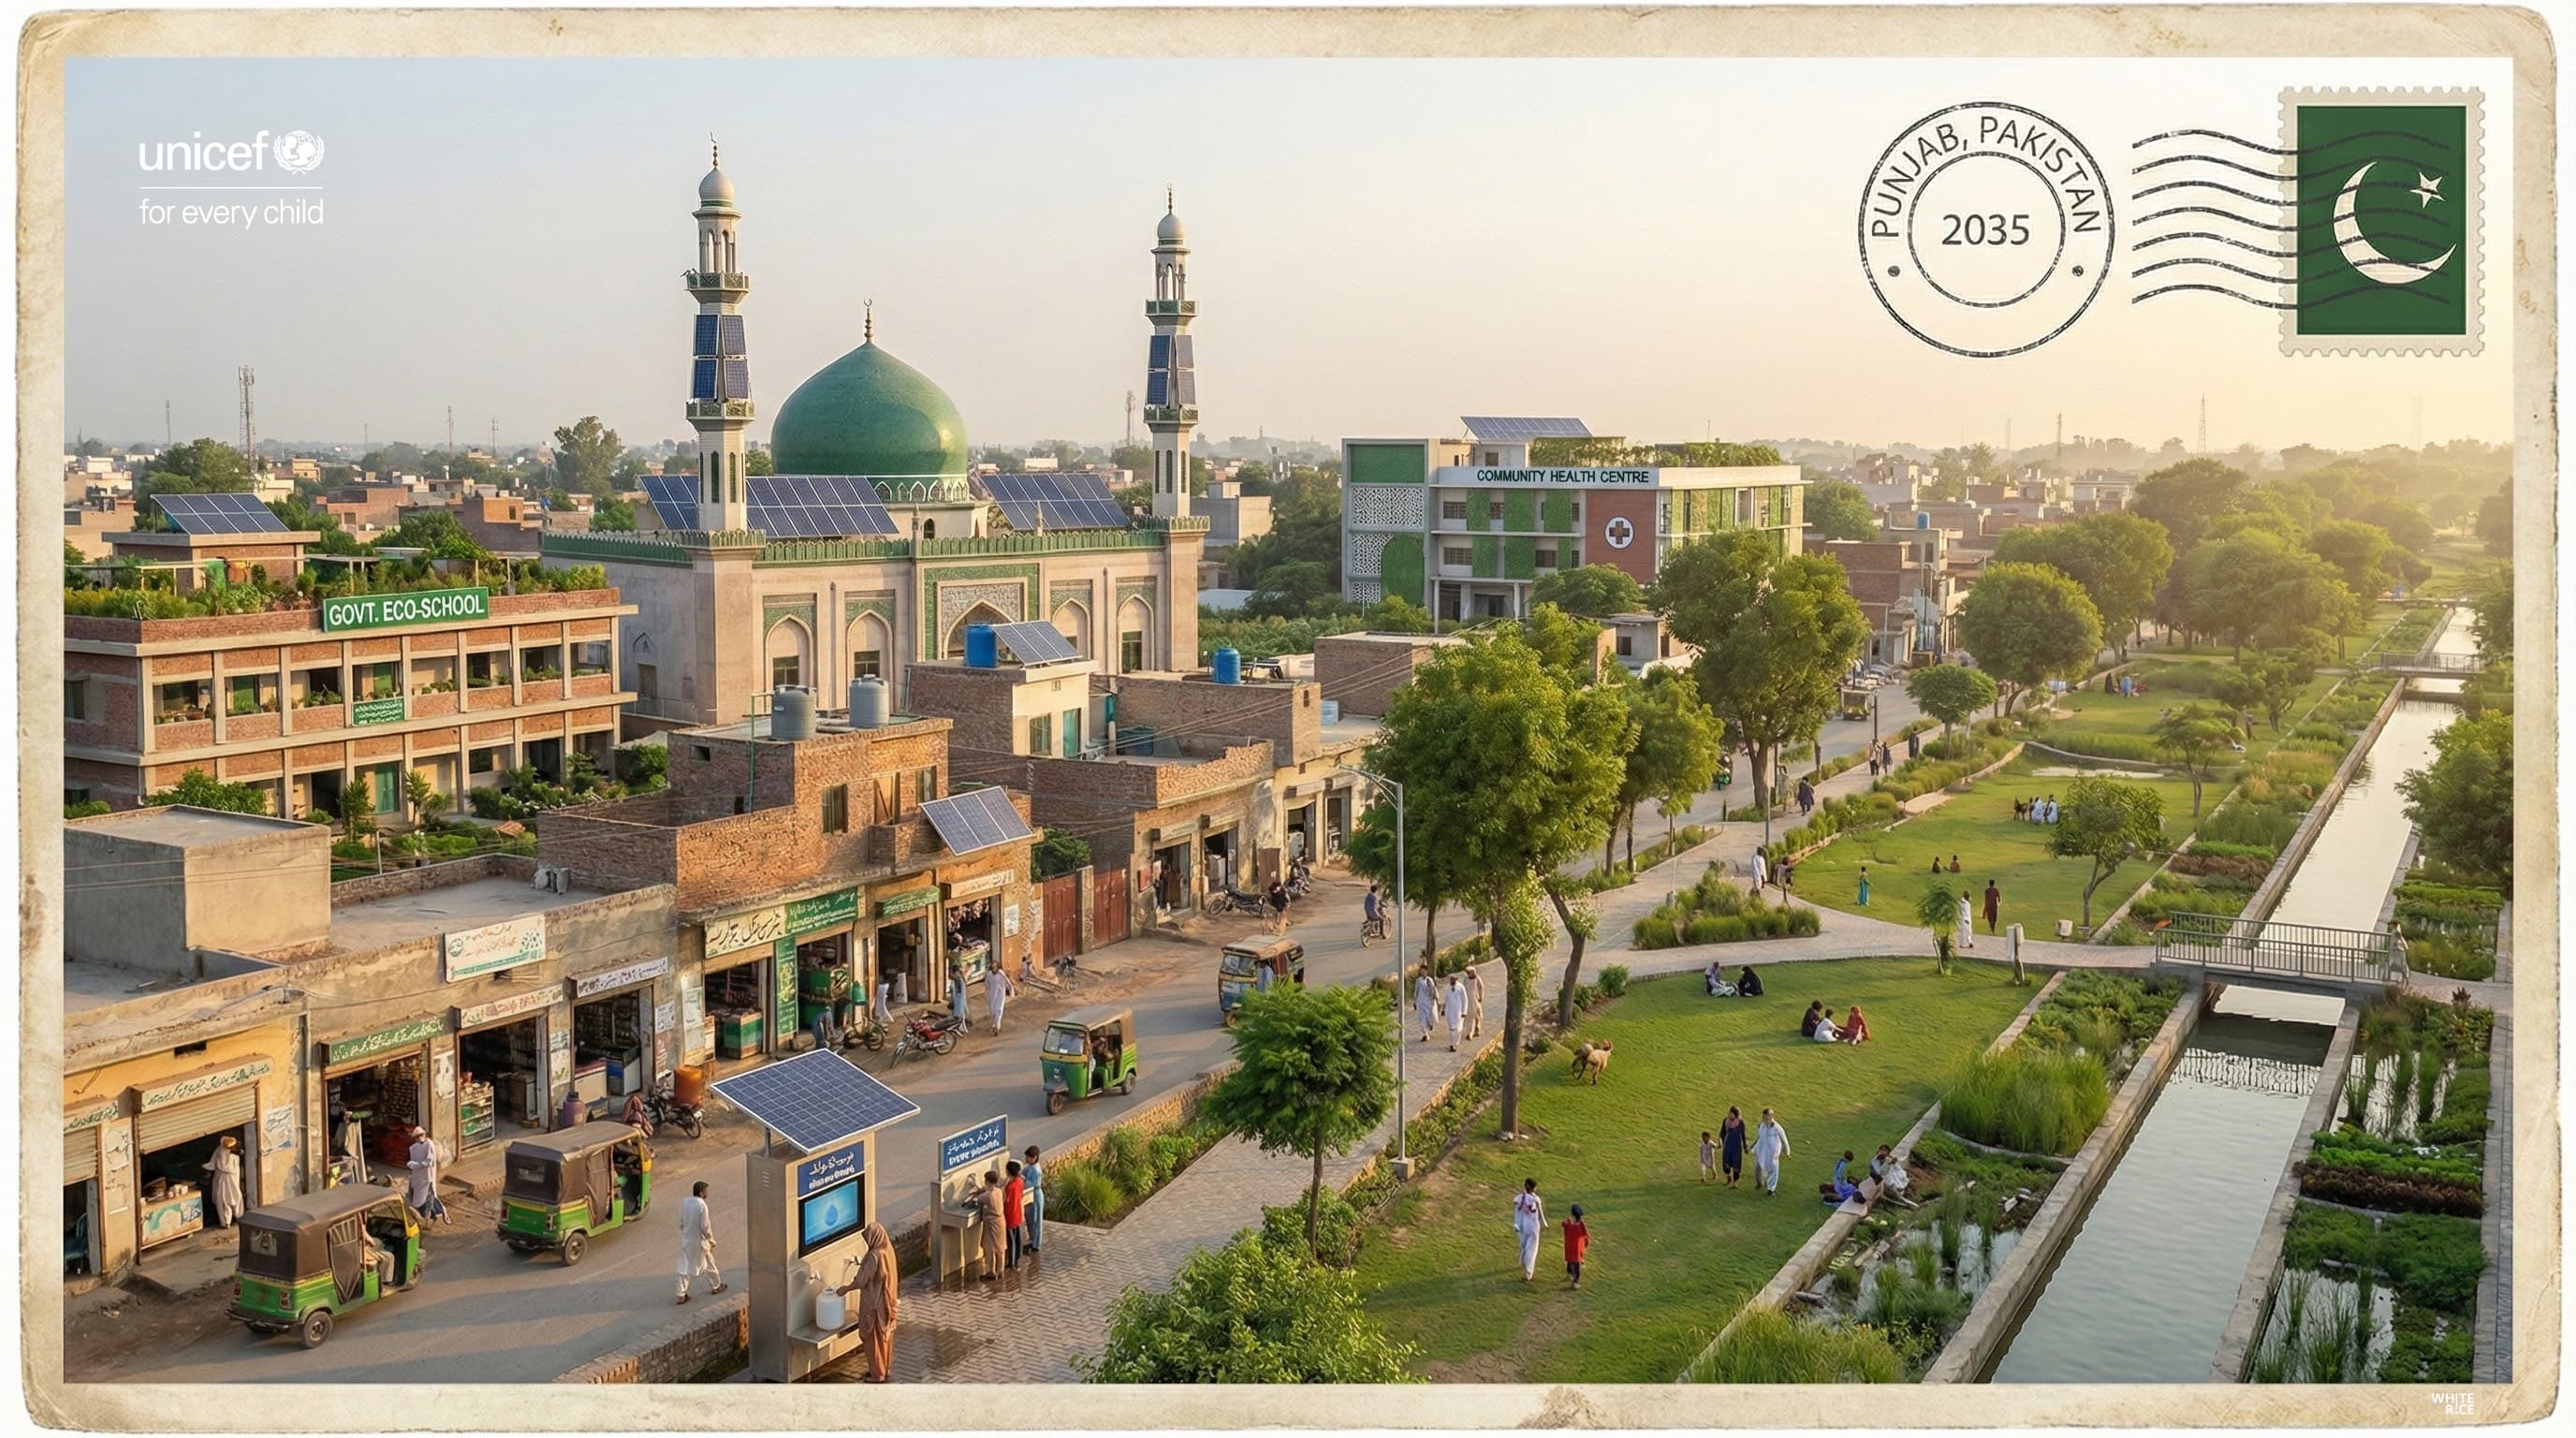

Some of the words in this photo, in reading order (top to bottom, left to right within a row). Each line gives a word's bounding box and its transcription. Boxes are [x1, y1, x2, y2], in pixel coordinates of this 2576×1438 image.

[1476, 470, 1545, 482] COMMUNITY
[1550, 470, 1596, 483] HEALTH
[1600, 471, 1649, 483] CENTRE
[329, 602, 379, 626] GOVT.
[383, 594, 485, 623] ECO-SCHOOL
